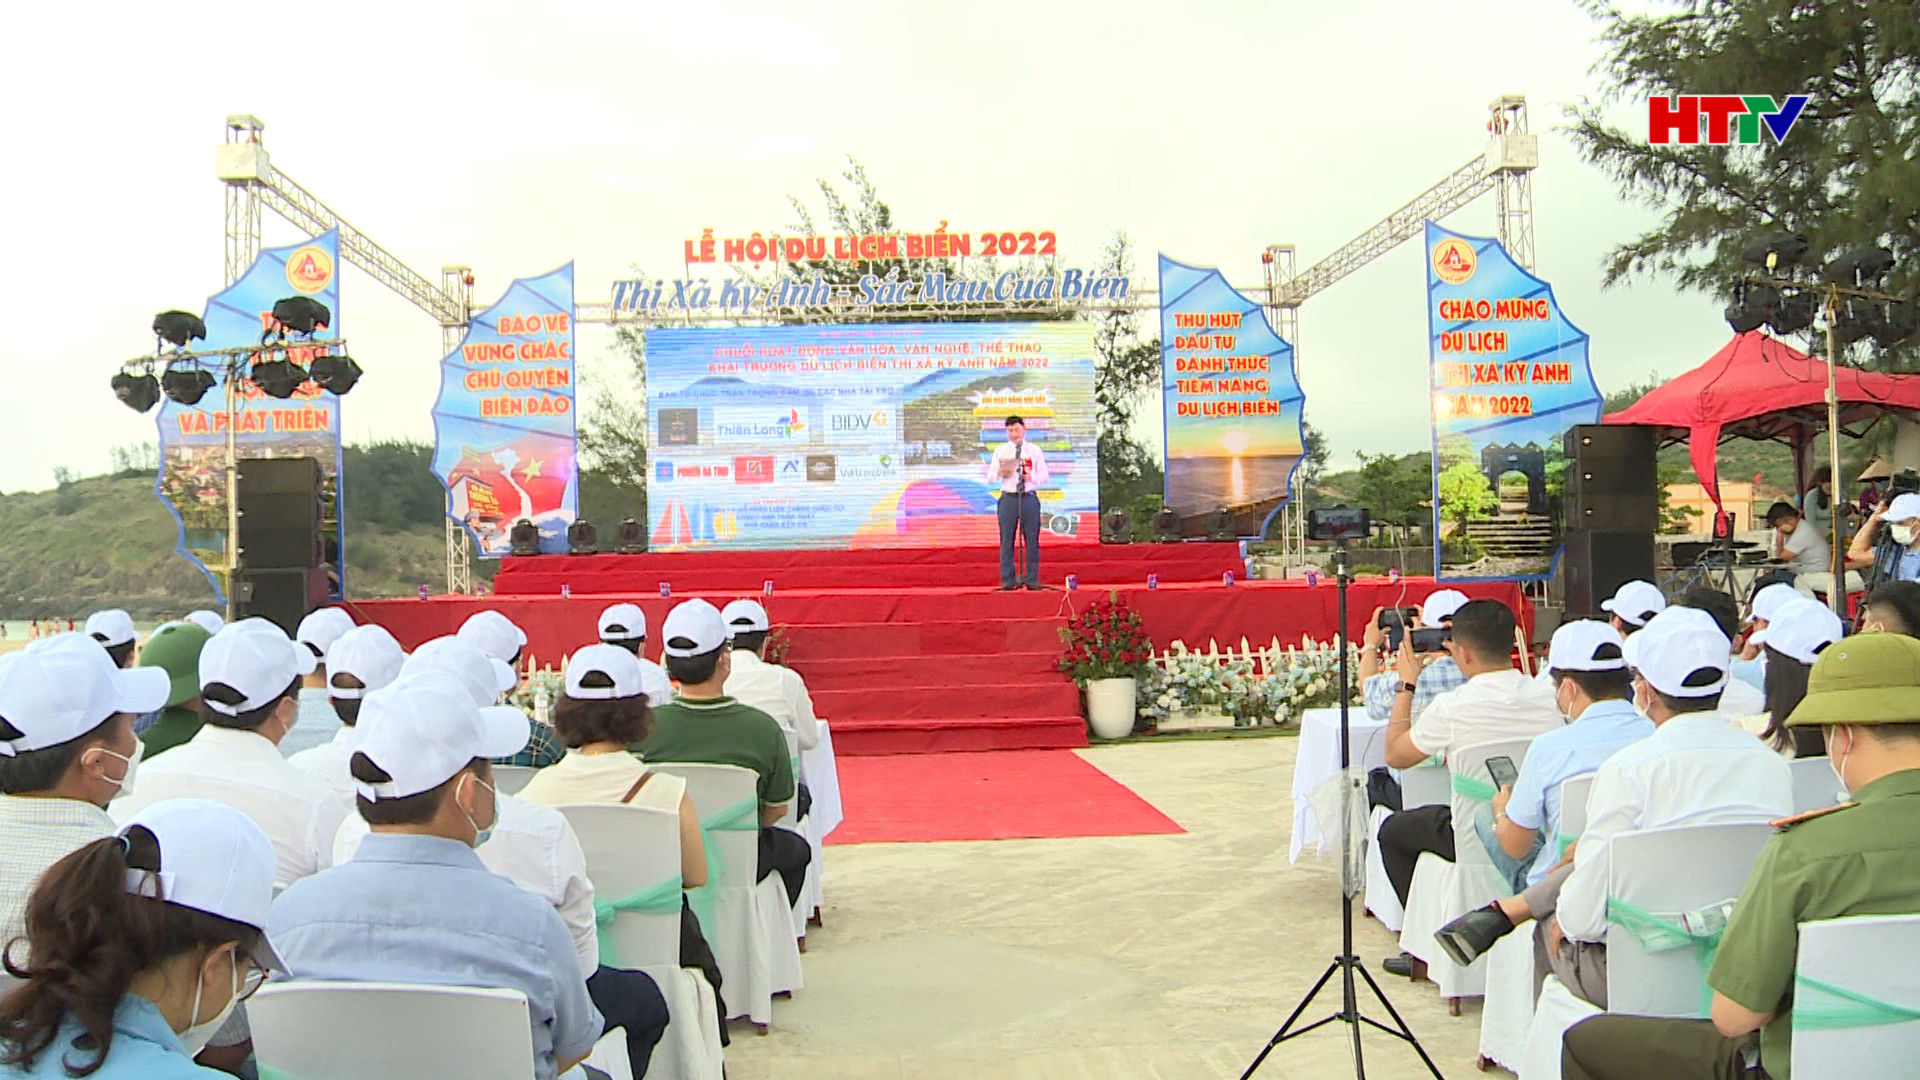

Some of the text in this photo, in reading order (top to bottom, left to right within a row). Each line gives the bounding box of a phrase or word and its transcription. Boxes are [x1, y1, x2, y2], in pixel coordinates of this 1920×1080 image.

[685, 220, 1056, 269] LỄ HỘI DU LỊCH BIỂN 2022
[612, 280, 662, 317] Thị
[667, 279, 711, 309] Xã
[765, 276, 831, 307] Anh
[857, 267, 914, 305] Sắc
[1174, 313, 1206, 328] THU
[1440, 331, 1507, 354] DU LỊCH
[1531, 362, 1571, 384] ANH
[1177, 401, 1201, 416] DU
[1203, 401, 1239, 417] LỊCH
[1489, 395, 1533, 416] 2022
[831, 414, 872, 431] BIDV
